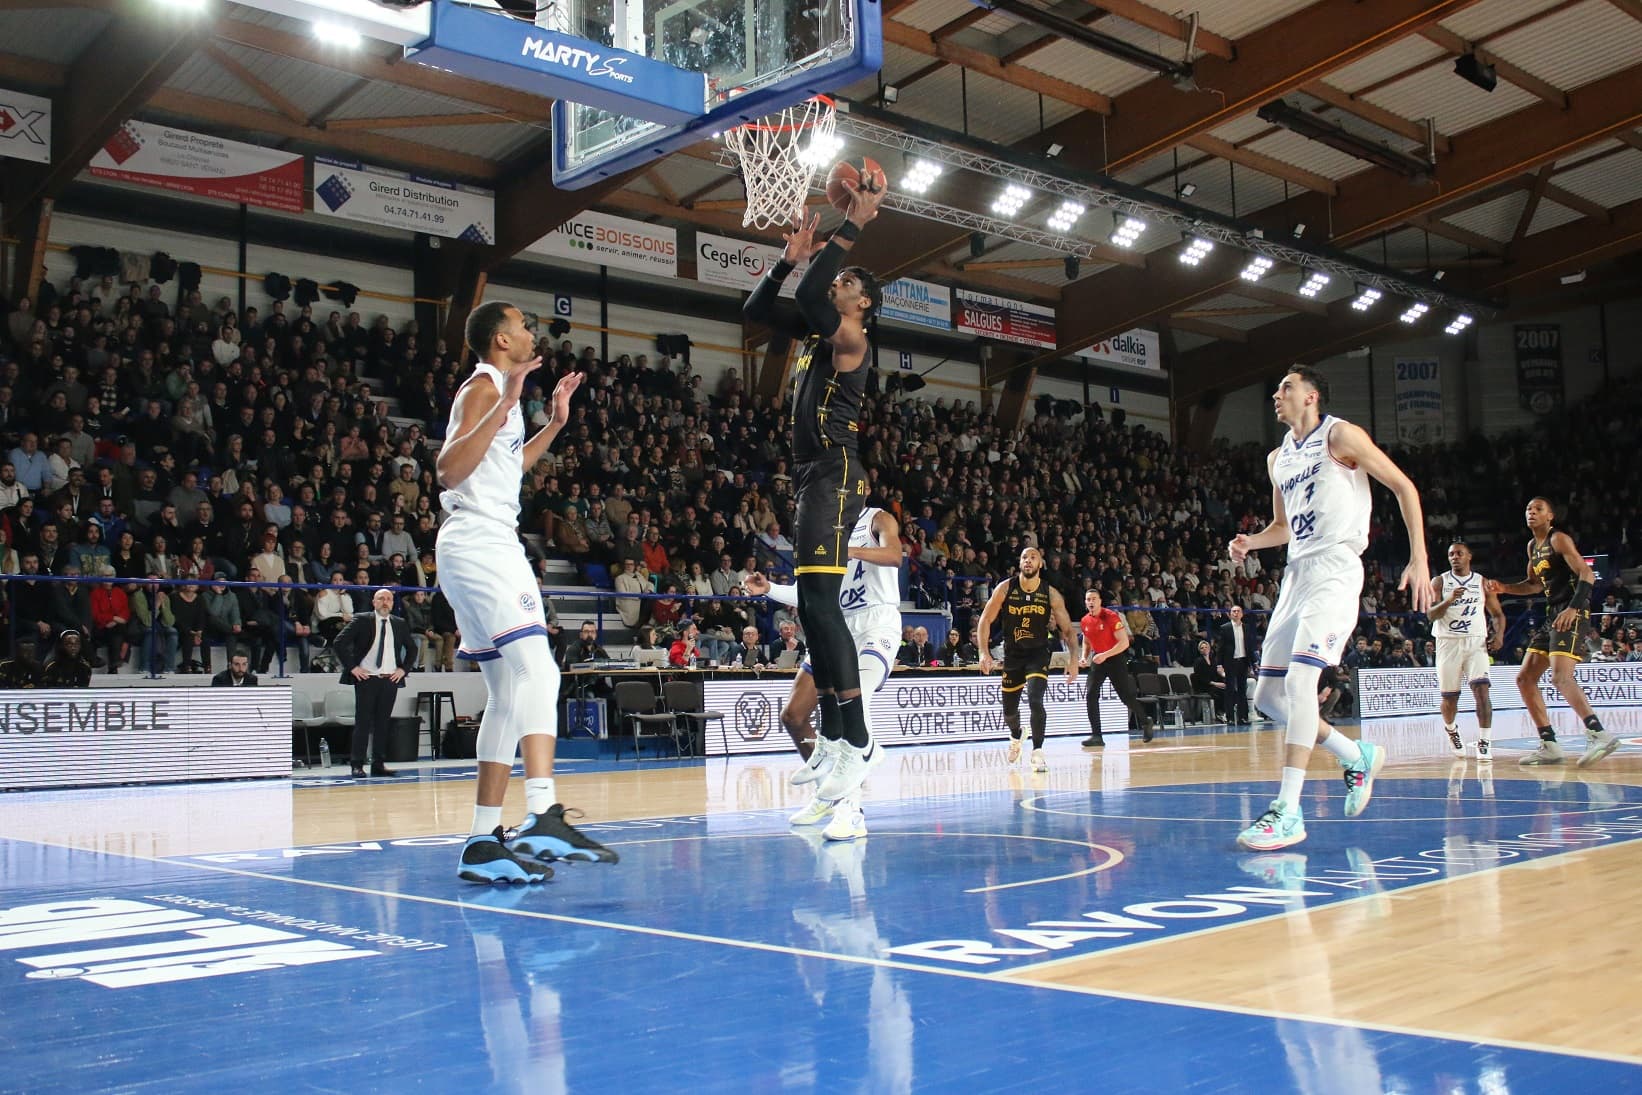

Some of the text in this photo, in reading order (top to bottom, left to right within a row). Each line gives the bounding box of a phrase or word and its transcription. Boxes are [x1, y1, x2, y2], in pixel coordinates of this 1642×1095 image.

[522, 36, 599, 72] MARTY
[369, 181, 400, 196] Girerd
[402, 188, 459, 208] Distribution
[384, 204, 445, 224] 04.74.71.41.99
[596, 244, 620, 256] servir,
[621, 250, 648, 262] animer,
[700, 243, 760, 269] Cegelec
[557, 297, 570, 314] G
[964, 309, 1003, 332] SALGUES
[1112, 335, 1146, 357] dalkia
[1518, 330, 1559, 348] 2007
[901, 354, 911, 368] H
[1397, 362, 1437, 380] 2007
[857, 480, 864, 495] 21
[1305, 481, 1315, 504] 7
[853, 560, 866, 581] 4
[1365, 673, 1438, 690] CONSTRUISONS
[896, 684, 1030, 709] CONSTRUISOS
[1366, 692, 1436, 711] VOTRE TRAVAIL
[897, 712, 955, 736] VOTRE
[885, 886, 1334, 965] RAVON
